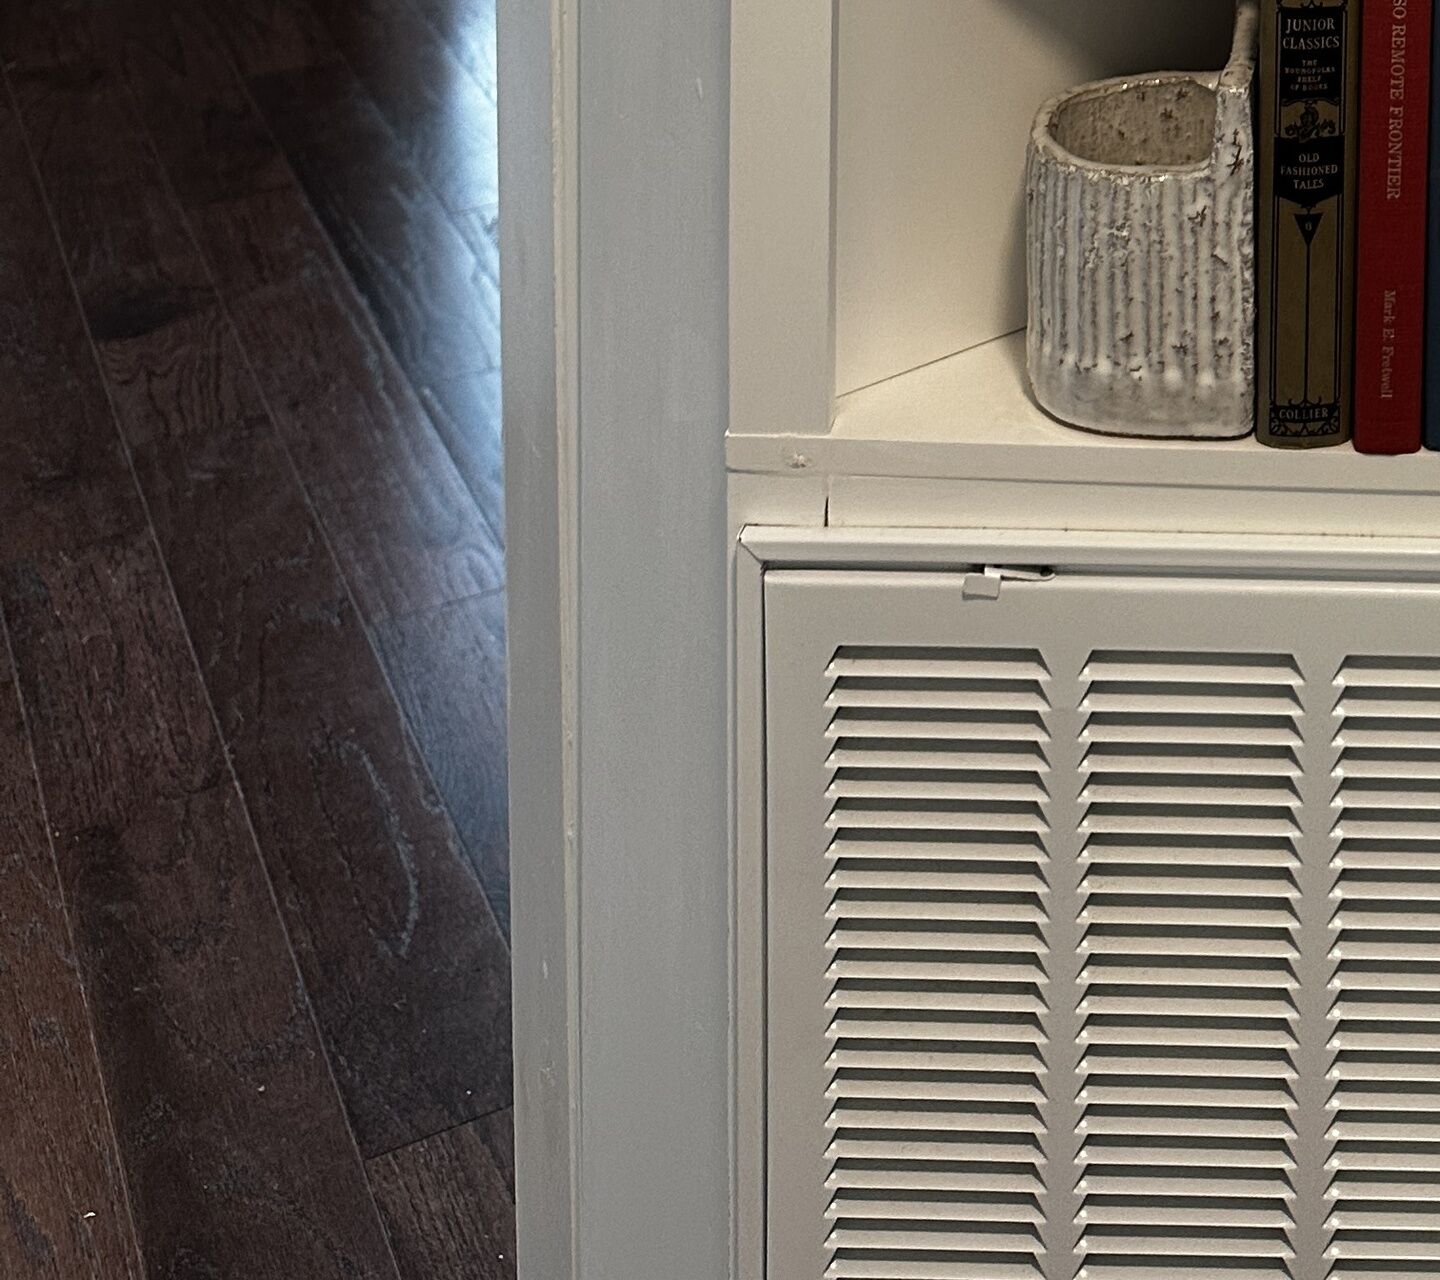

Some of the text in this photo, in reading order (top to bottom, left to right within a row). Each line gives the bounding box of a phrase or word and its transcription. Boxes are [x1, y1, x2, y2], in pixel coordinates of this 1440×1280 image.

[1285, 17, 1335, 34] JUNIOR
[1282, 36, 1340, 50] CLASSICS
[1390, 24, 1407, 101] REMOTE
[1298, 152, 1320, 163] OLD
[1387, 106, 1404, 200] FRONTIER
[1280, 164, 1338, 176] FASHIONED
[1293, 179, 1324, 190] TALES
[1383, 289, 1396, 323] Mark
[1381, 346, 1394, 399] Fretwell
[1279, 408, 1329, 420] COLLIER
